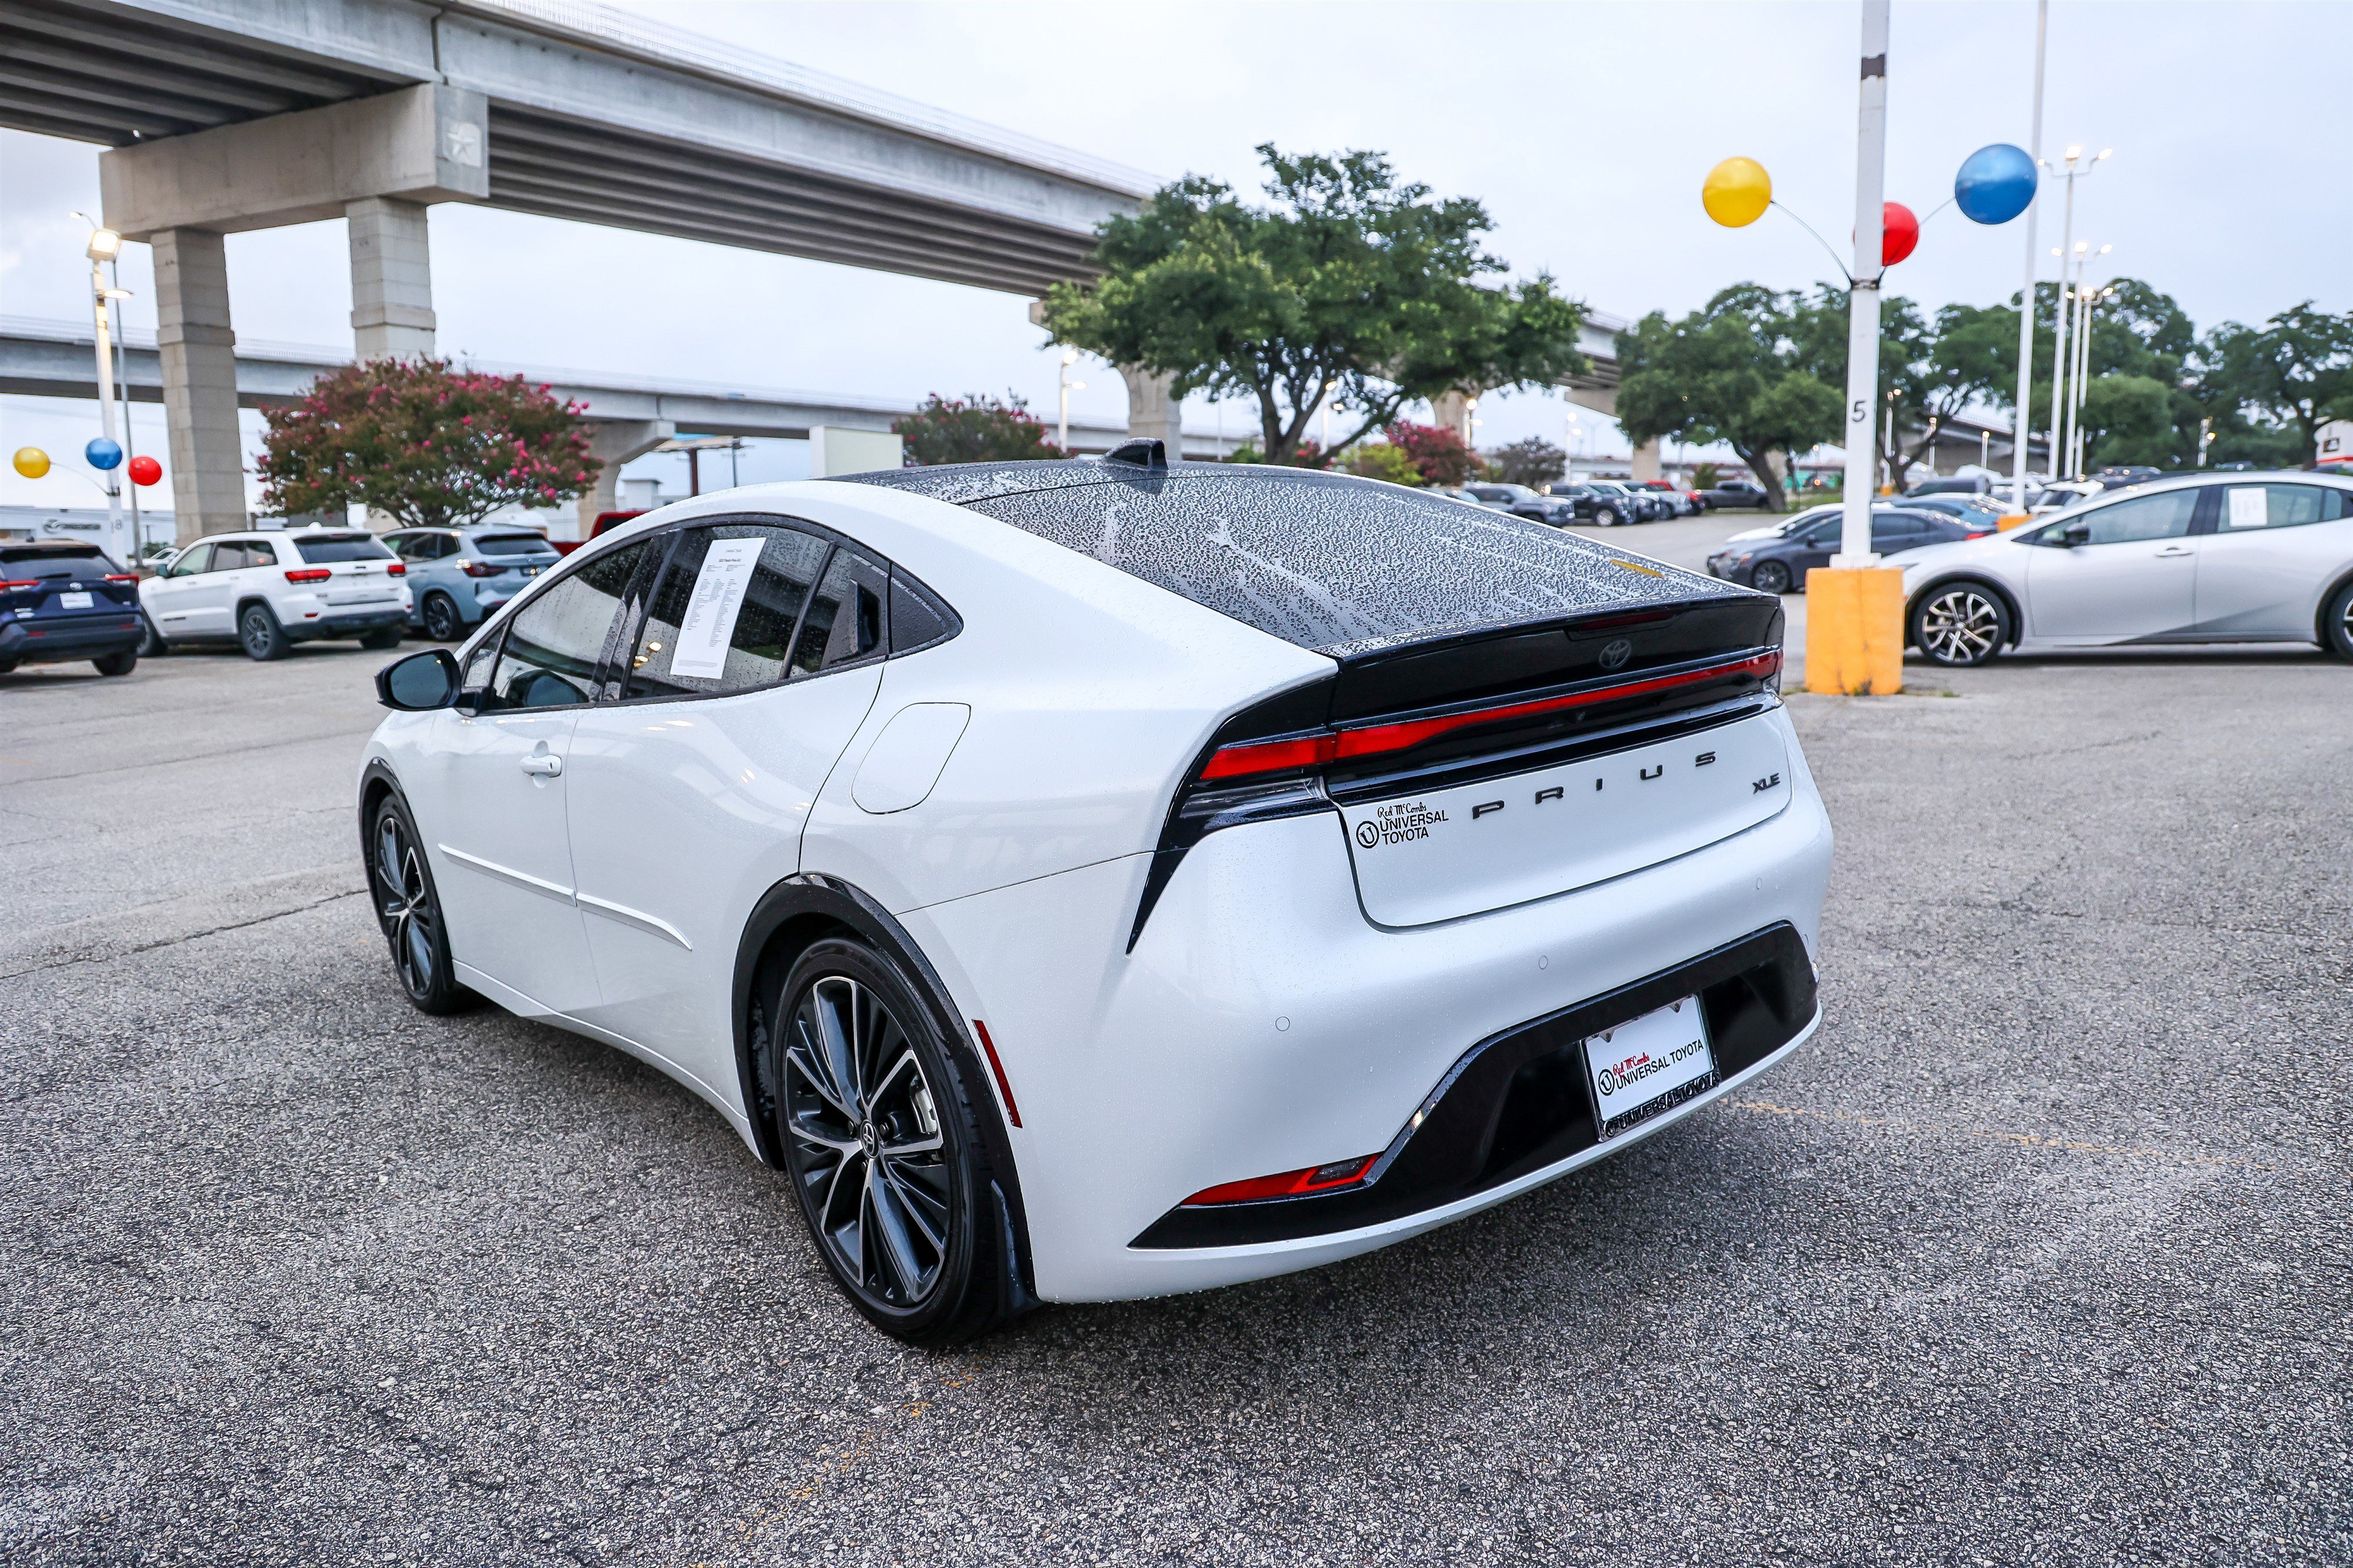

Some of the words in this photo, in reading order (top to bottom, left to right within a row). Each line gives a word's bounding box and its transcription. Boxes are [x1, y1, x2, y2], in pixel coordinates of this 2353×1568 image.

[1852, 400, 1865, 422] 5
[1472, 751, 1717, 820] PRIUS
[1752, 773, 1780, 794] XLE
[1377, 806, 1393, 821] Red
[1393, 801, 1427, 816] McCombs
[1379, 810, 1449, 832] UNIVERSAL
[1382, 827, 1429, 845] TOYOTA
[1613, 1062, 1625, 1078] Red
[1615, 1056, 1671, 1090] UNIVERSAL
[1669, 1038, 1704, 1064] TOYOTA
[1619, 1091, 1682, 1129] UNIVERSAL
[1677, 1071, 1719, 1100] TOYOTA
